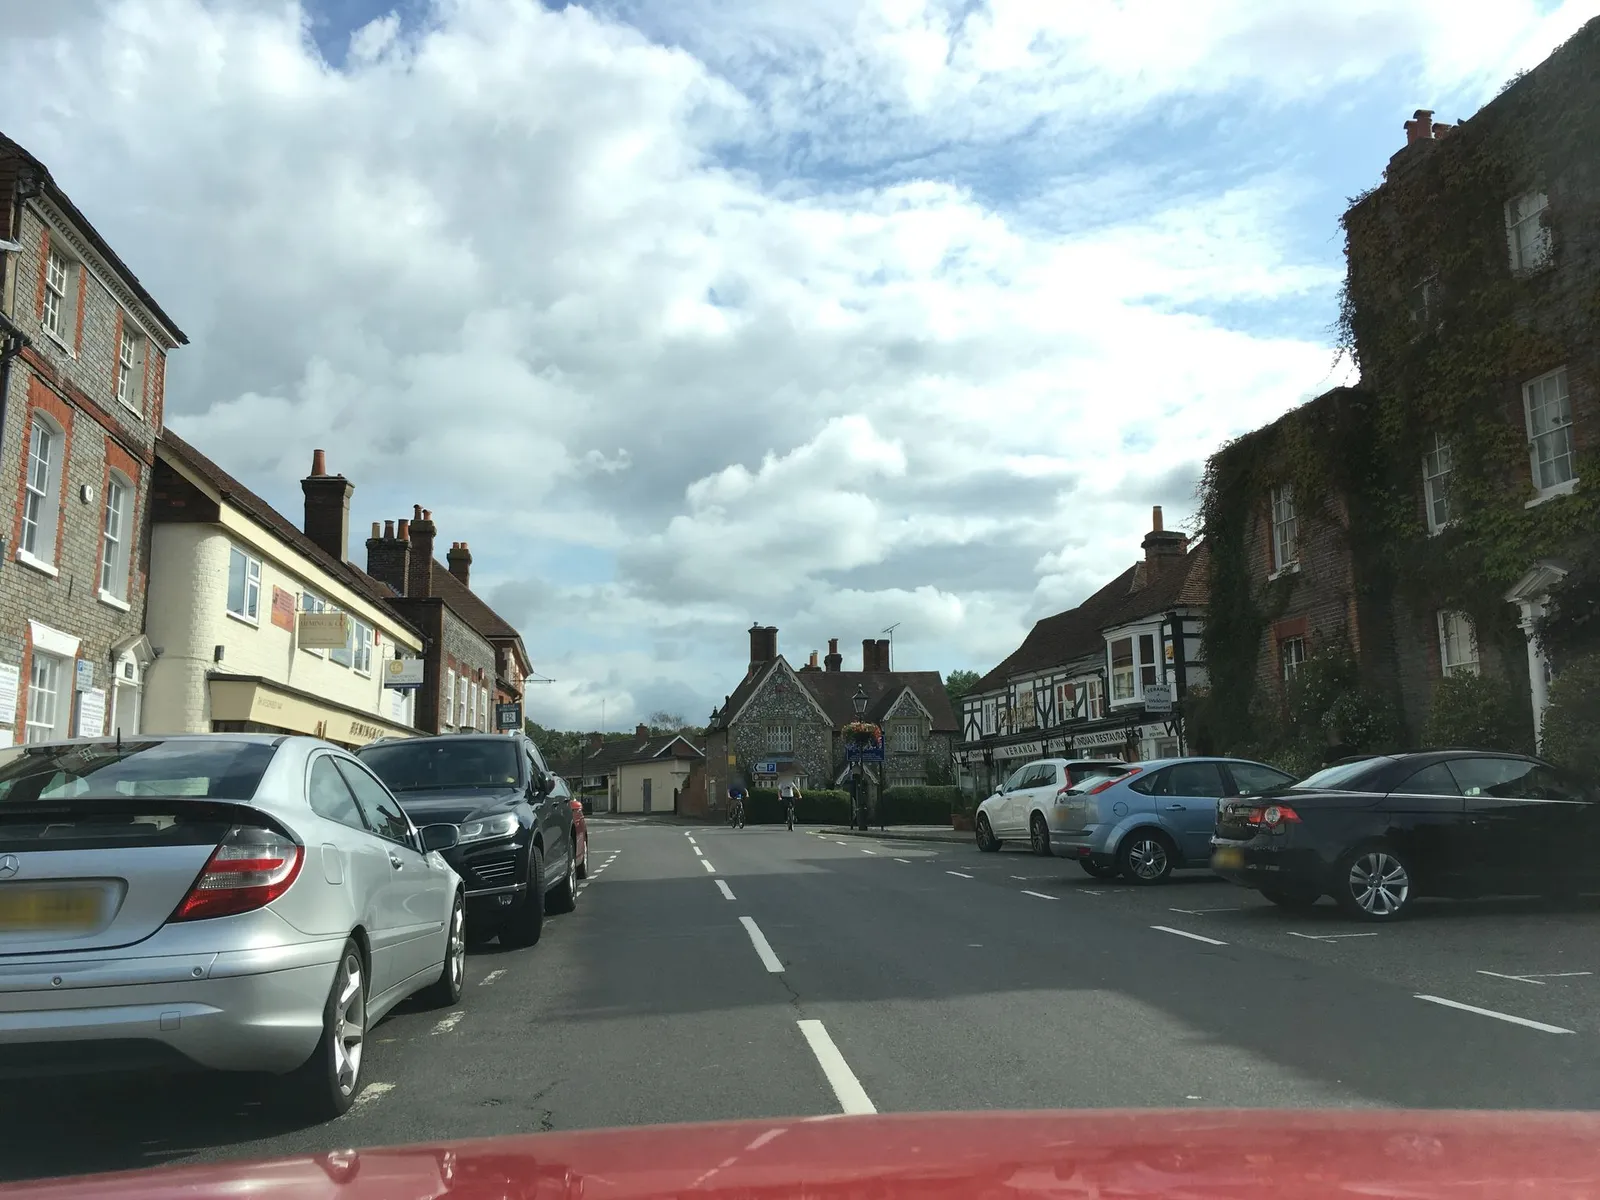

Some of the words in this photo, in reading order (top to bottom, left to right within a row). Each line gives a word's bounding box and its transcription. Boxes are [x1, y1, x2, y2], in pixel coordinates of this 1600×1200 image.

[300, 619, 326, 627] HEMING
[1003, 743, 1038, 756] VERANDA
[1076, 735, 1096, 745] INDIAN
